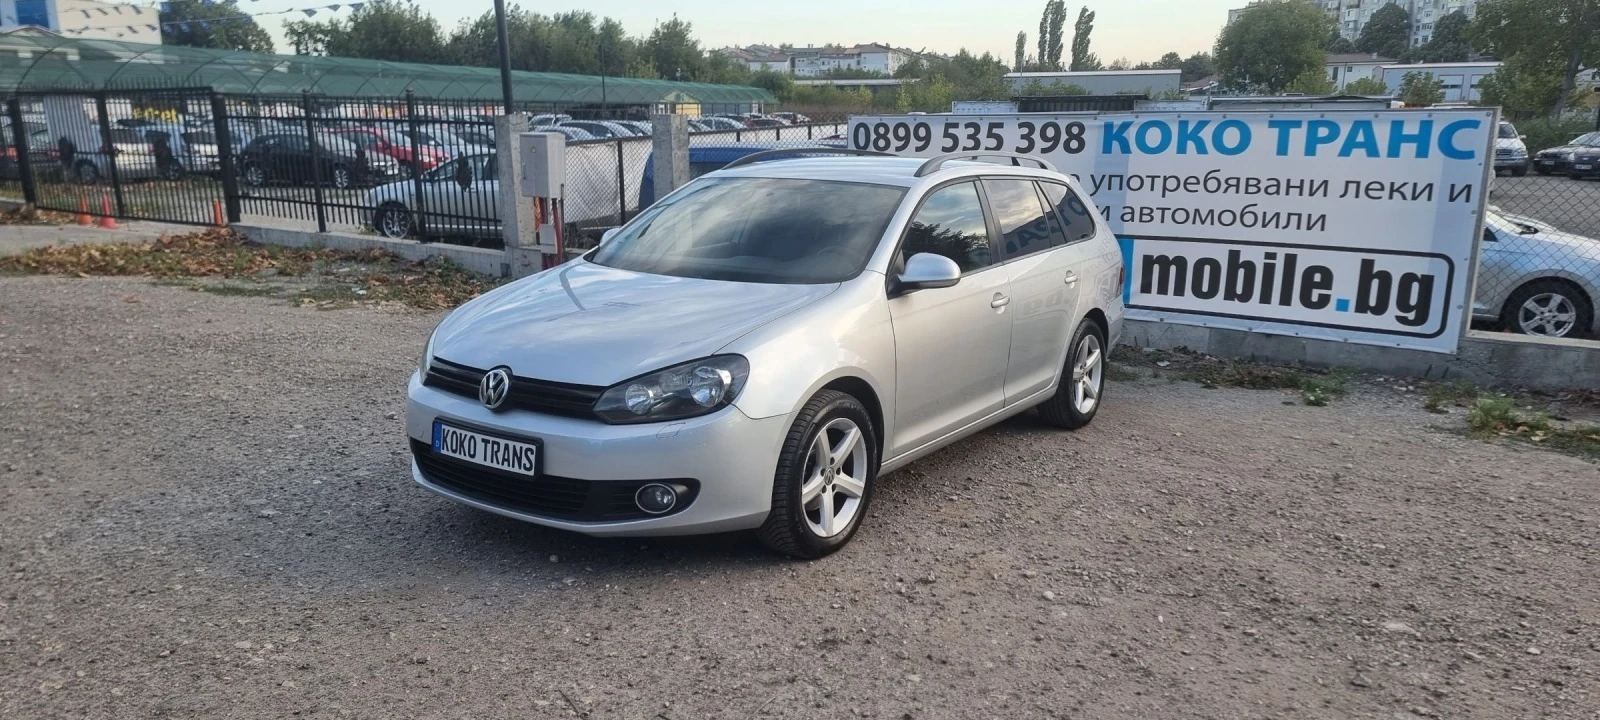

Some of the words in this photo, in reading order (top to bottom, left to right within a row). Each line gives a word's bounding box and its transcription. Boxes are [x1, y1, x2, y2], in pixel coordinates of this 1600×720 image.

[852, 121, 932, 152] 0899
[941, 122, 1005, 152] 535
[1015, 121, 1086, 154] 398
[1101, 119, 1252, 156] КОКО
[1268, 119, 1482, 160] ТРАНС
[1090, 169, 1329, 198] употребявани
[1340, 179, 1434, 202] леки
[1449, 184, 1472, 203] и
[1120, 204, 1327, 232] автомобили
[1139, 249, 1435, 327] mobile.bg
[441, 428, 477, 459] KOKO
[481, 438, 535, 472] TRANS
